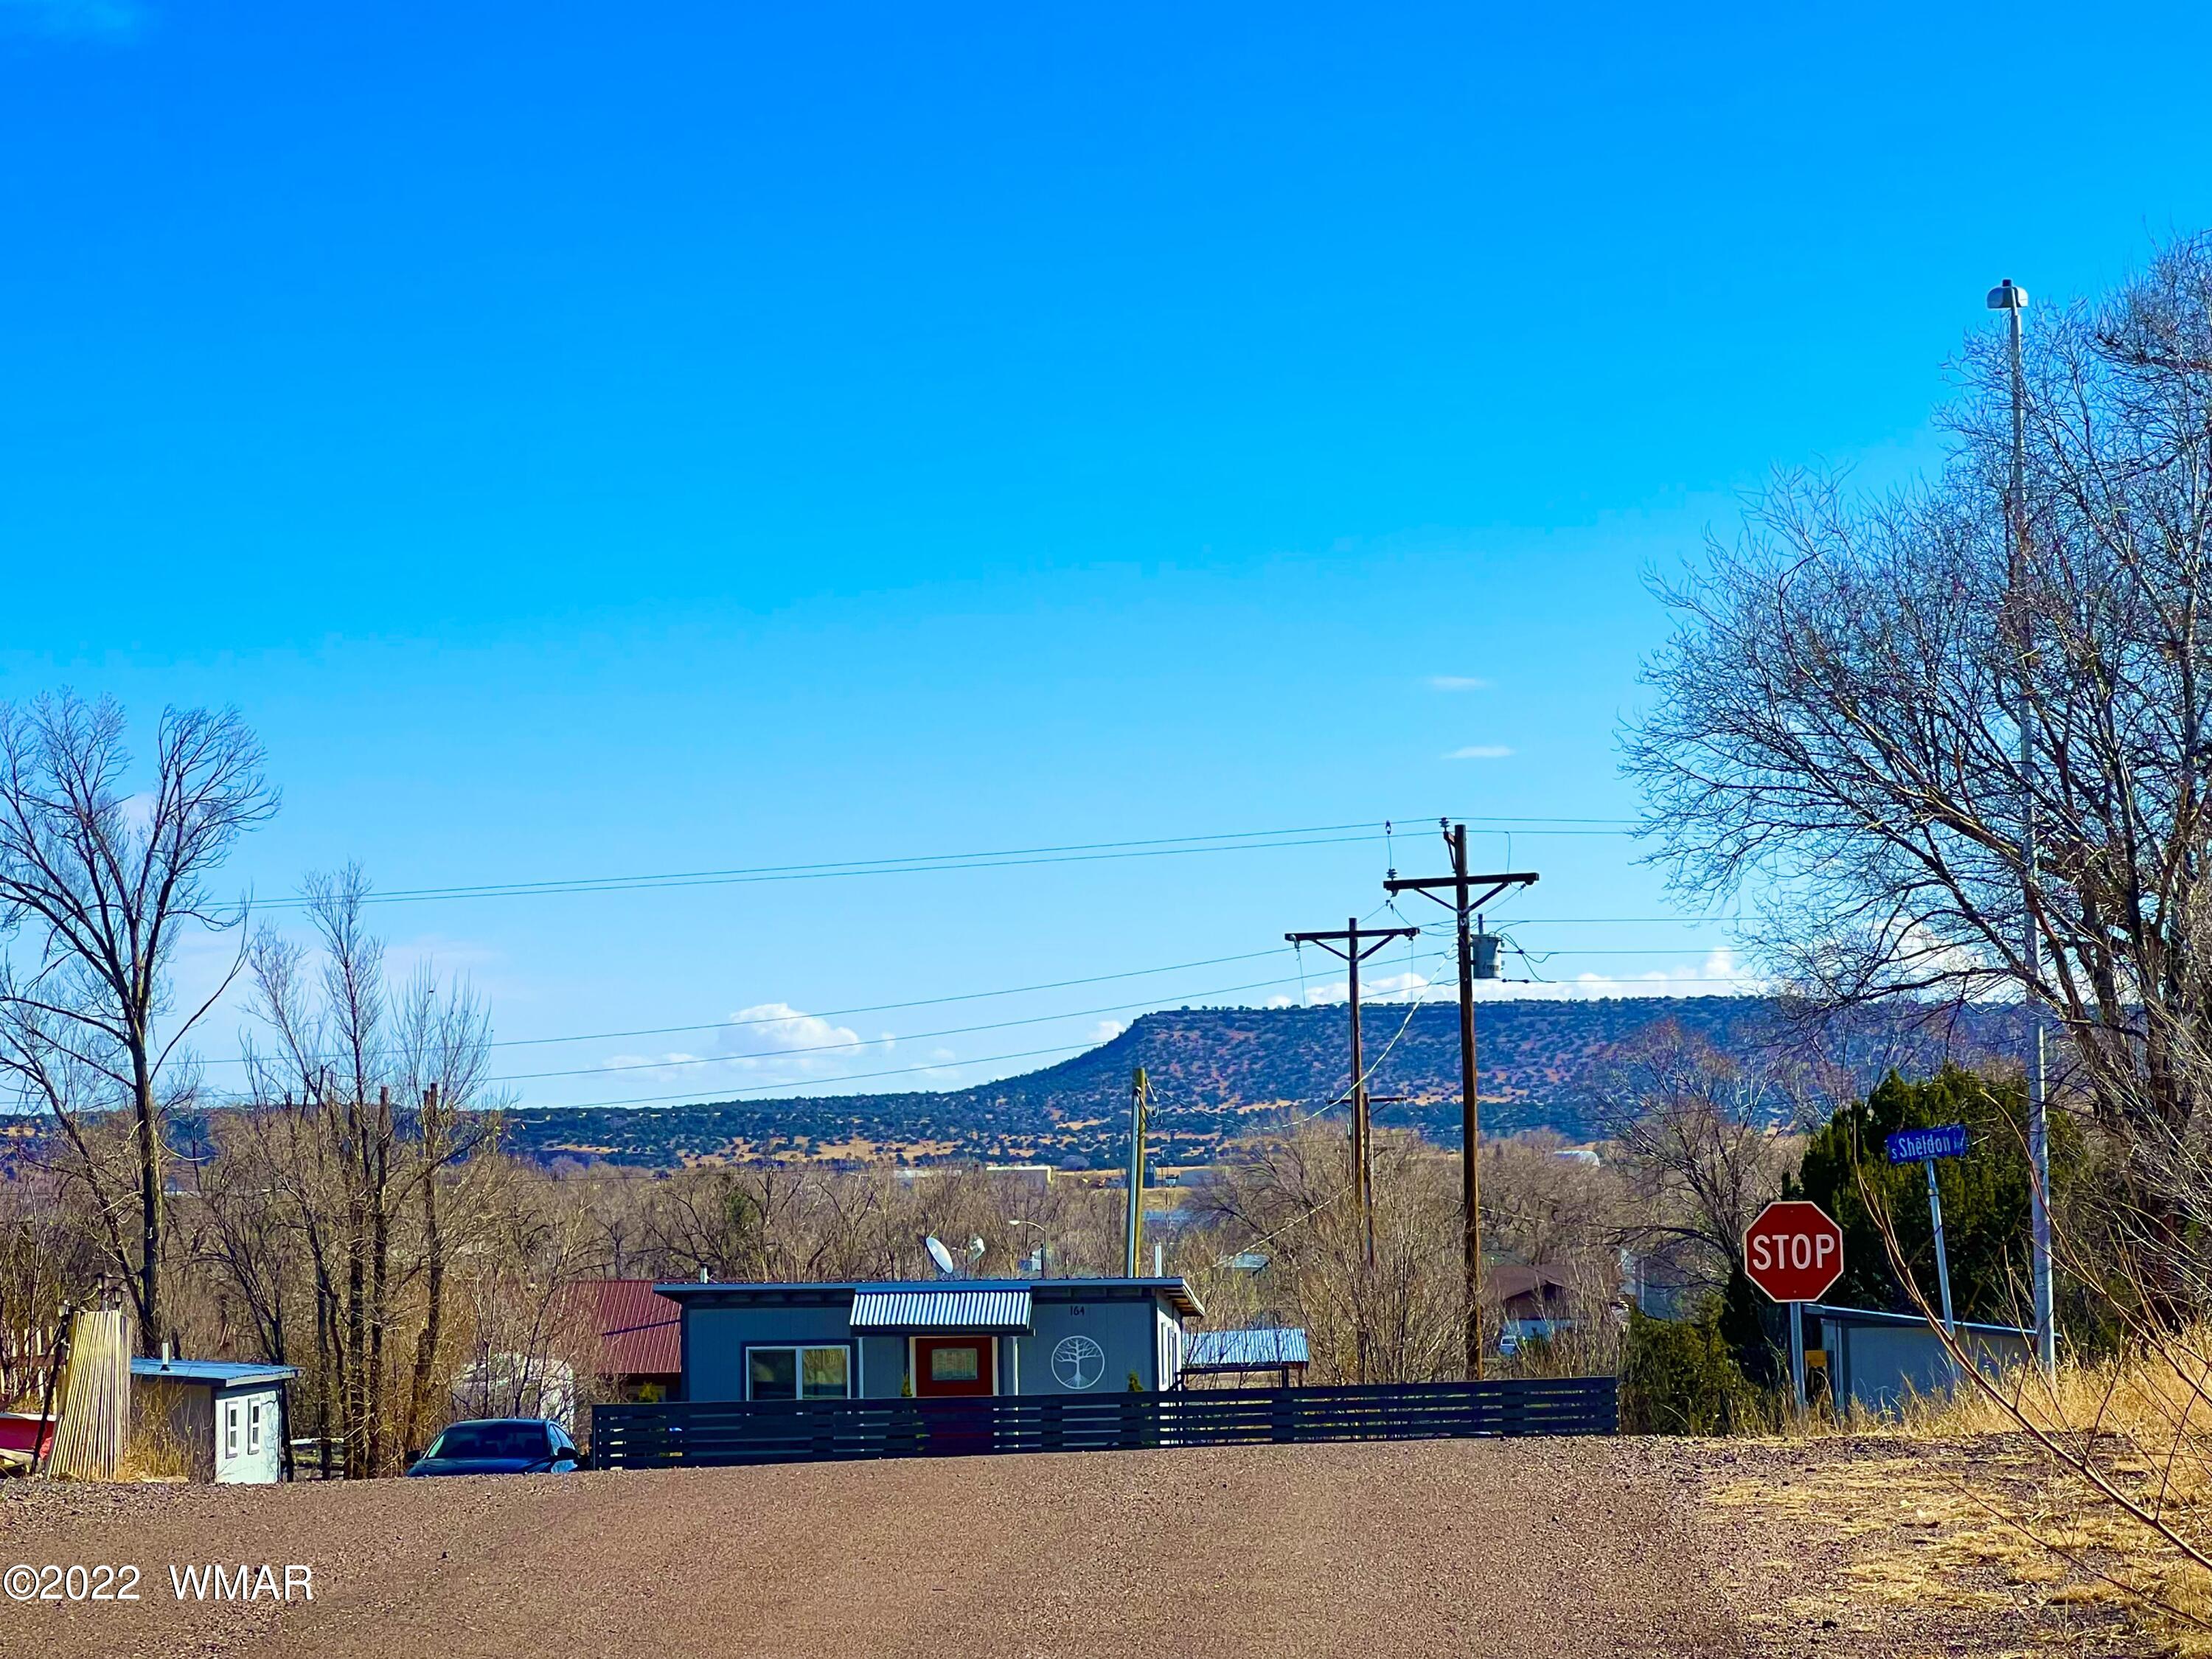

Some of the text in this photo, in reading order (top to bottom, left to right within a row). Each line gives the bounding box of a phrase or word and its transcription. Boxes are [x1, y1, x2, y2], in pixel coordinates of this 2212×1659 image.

[1898, 1134, 1950, 1158] Sheldon
[1752, 1234, 1835, 1270] STOP
[1070, 1305, 1085, 1316] 164
